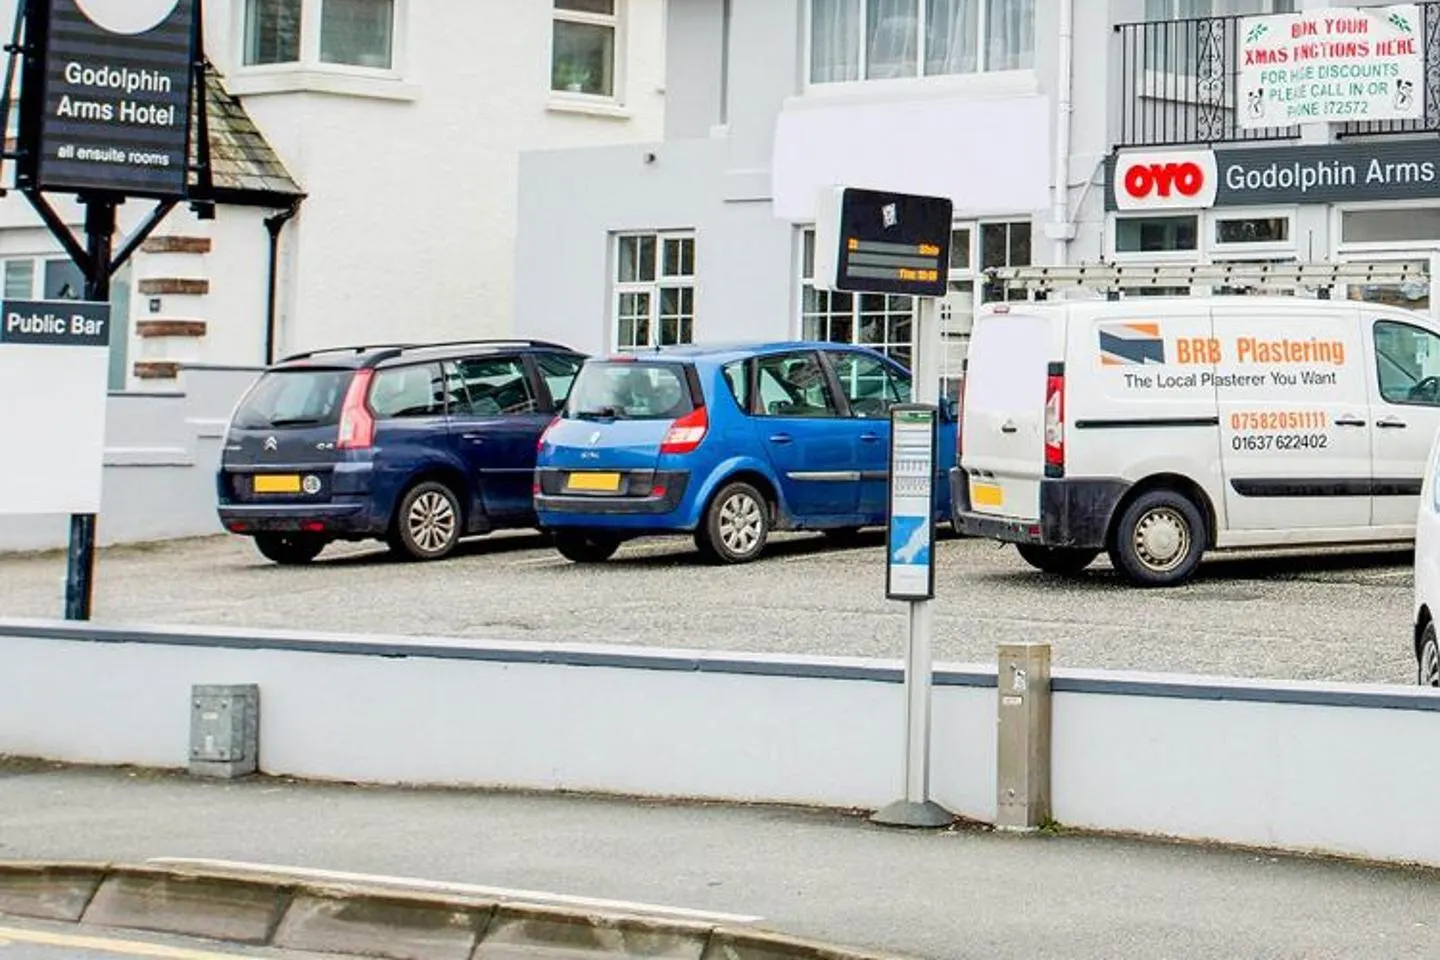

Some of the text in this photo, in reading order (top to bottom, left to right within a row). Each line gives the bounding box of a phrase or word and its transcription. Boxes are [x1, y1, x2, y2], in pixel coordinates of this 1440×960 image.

[1244, 46, 1288, 65] XMAS
[65, 62, 171, 94] Godolphin
[1260, 69, 1287, 84] FOR
[1318, 62, 1400, 79] DISCOUNTS
[1310, 83, 1345, 98] CALL
[1349, 82, 1362, 96] IN
[1368, 81, 1389, 95] OR
[57, 95, 175, 126] Arms Hotel
[57, 144, 170, 166] all ensuite rooms
[1124, 162, 1205, 199] OYO
[1226, 157, 1356, 192] Godolphin
[1365, 158, 1435, 184] Arms
[7, 312, 104, 336] Public Bar
[1176, 335, 1345, 366] BRB Plastering
[1124, 369, 1338, 389] The Local Plasterer You Want
[1232, 433, 1328, 451] 01637 622402
